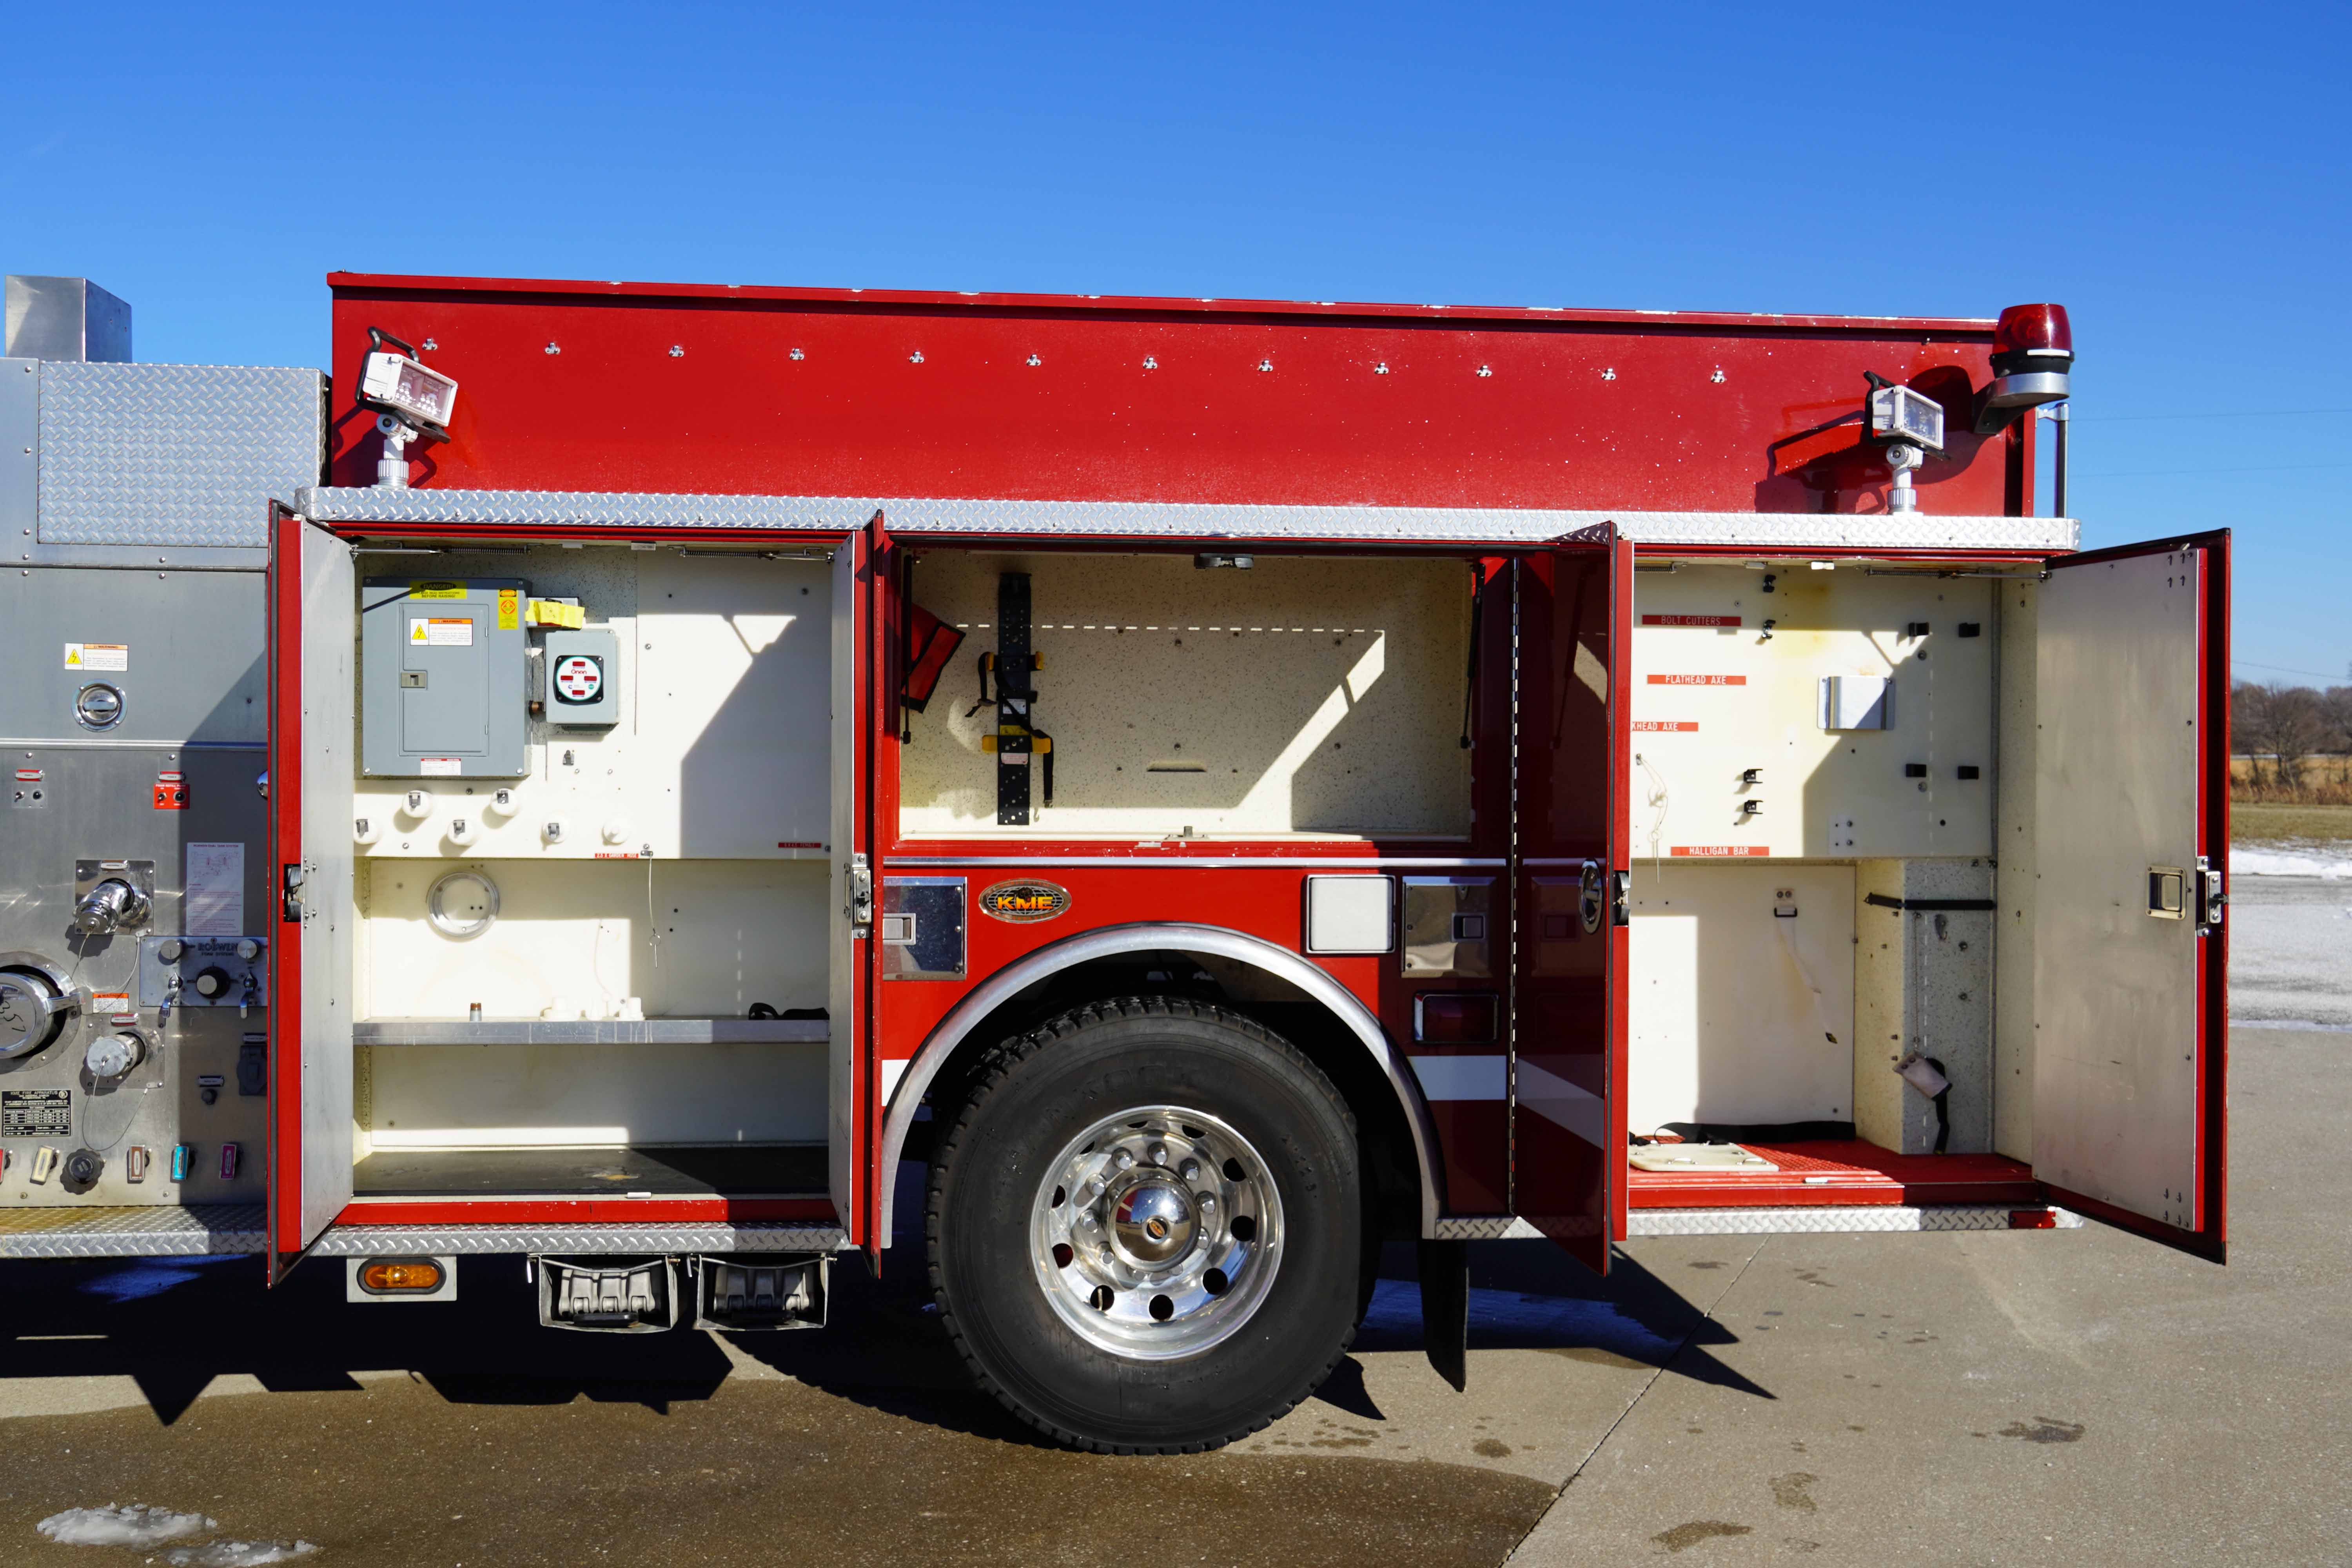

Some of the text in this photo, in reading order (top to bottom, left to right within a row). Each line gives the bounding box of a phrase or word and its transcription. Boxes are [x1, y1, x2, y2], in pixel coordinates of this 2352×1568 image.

[1661, 616, 1721, 625] BOLT CUTTERS
[1665, 675, 1727, 685] FLATHEAD AXE
[1662, 722, 1678, 731] AXE
[1689, 847, 1749, 855] HALLIGAN BAR
[997, 897, 1054, 910] KME
